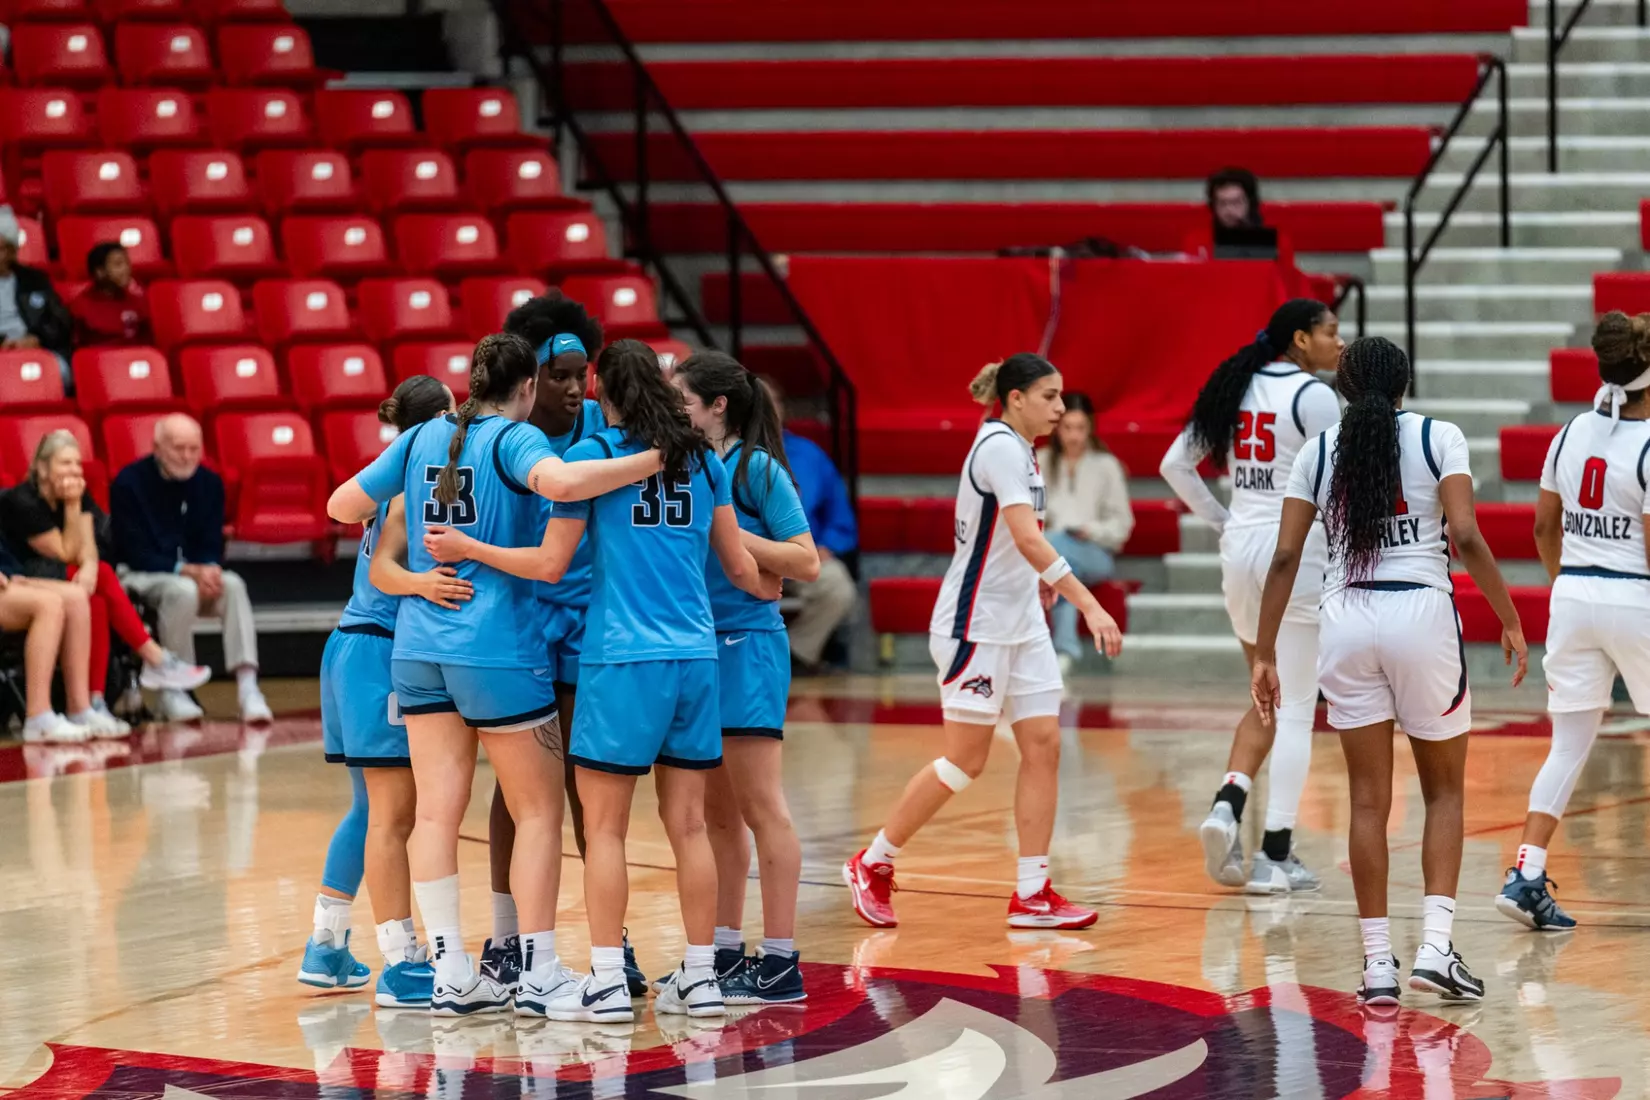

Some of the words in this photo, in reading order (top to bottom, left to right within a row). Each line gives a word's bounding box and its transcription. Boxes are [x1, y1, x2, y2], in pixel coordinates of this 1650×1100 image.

[1233, 409, 1277, 463] 25
[423, 464, 478, 527] 33
[631, 468, 693, 528] 35
[1234, 465, 1276, 491] CLARK
[1578, 455, 1608, 511] 0
[1564, 510, 1632, 540] GONZALEZ
